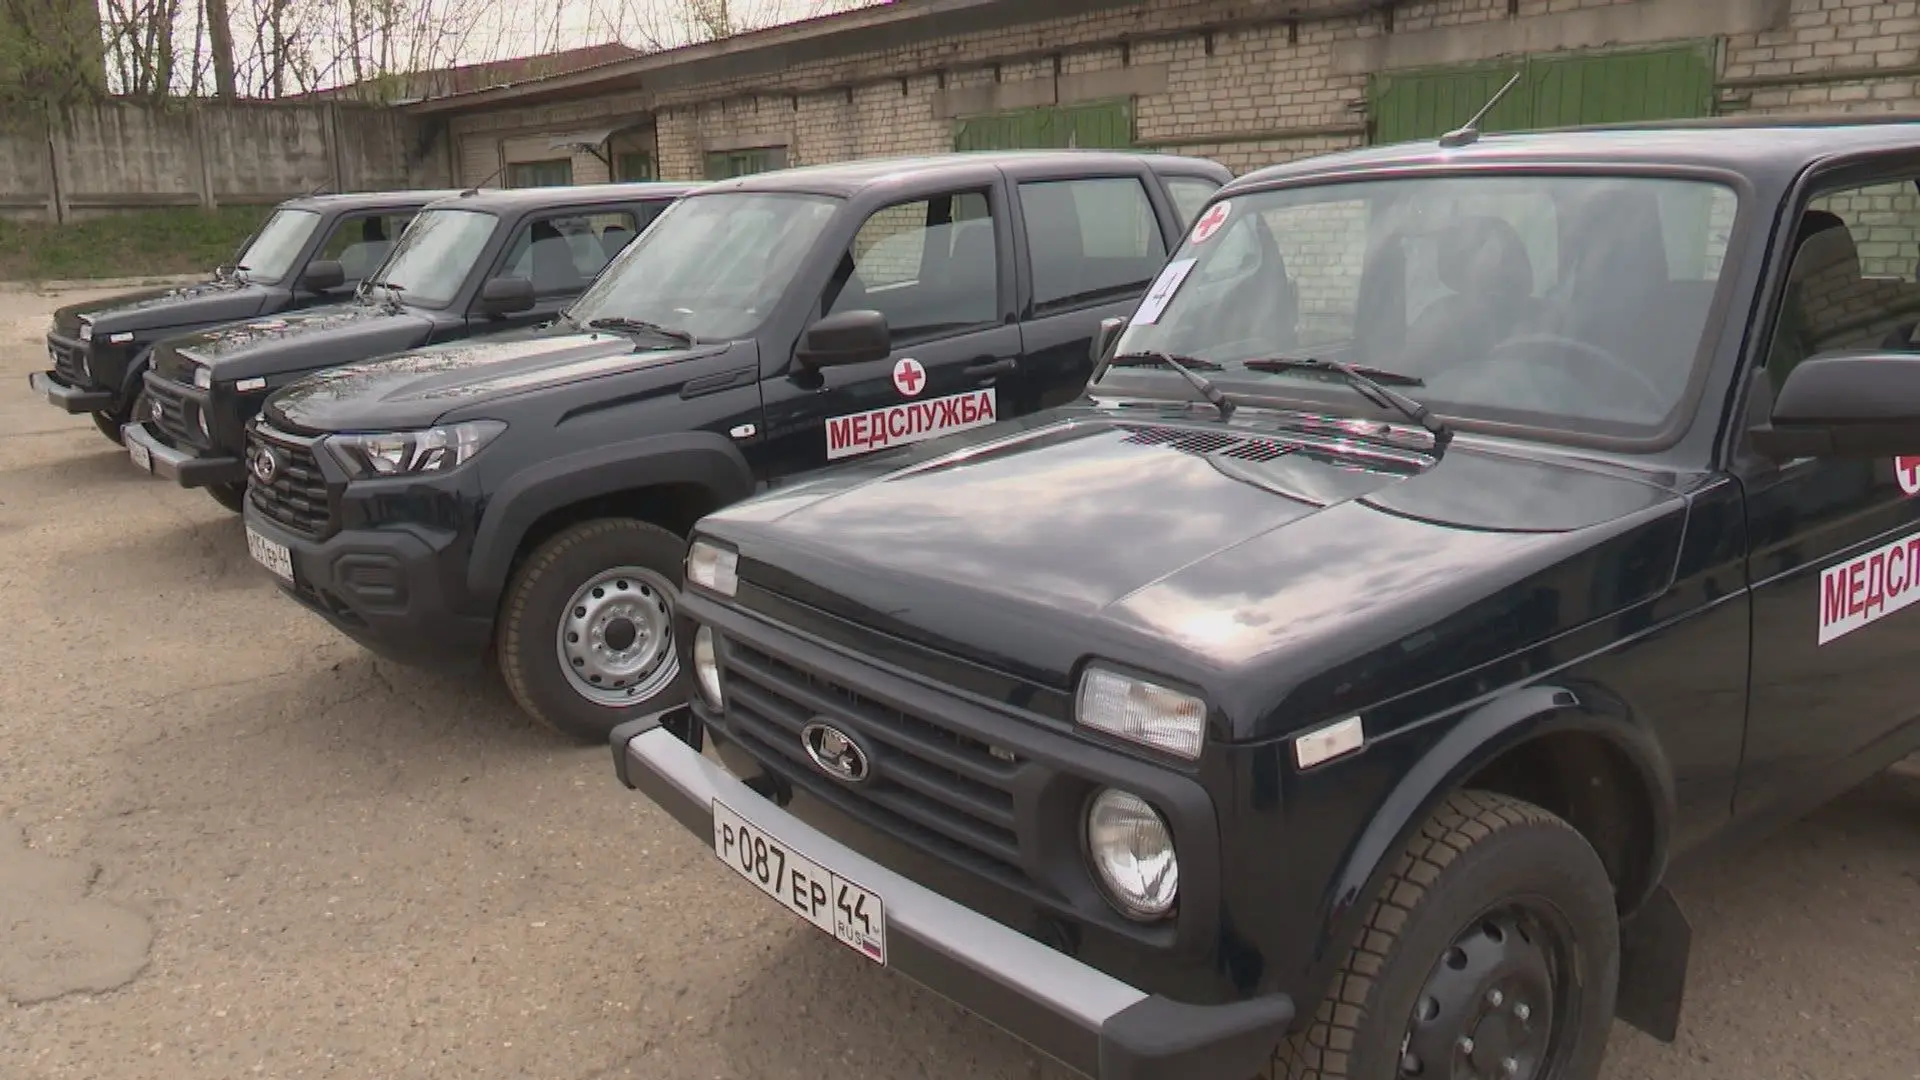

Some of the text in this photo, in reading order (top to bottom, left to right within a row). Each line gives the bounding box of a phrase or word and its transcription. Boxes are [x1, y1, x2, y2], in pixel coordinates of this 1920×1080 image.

[1152, 271, 1179, 307] 4
[829, 391, 994, 450] МЕДСЛУЖБА
[837, 884, 871, 934] 44
[837, 919, 863, 946] RUS
